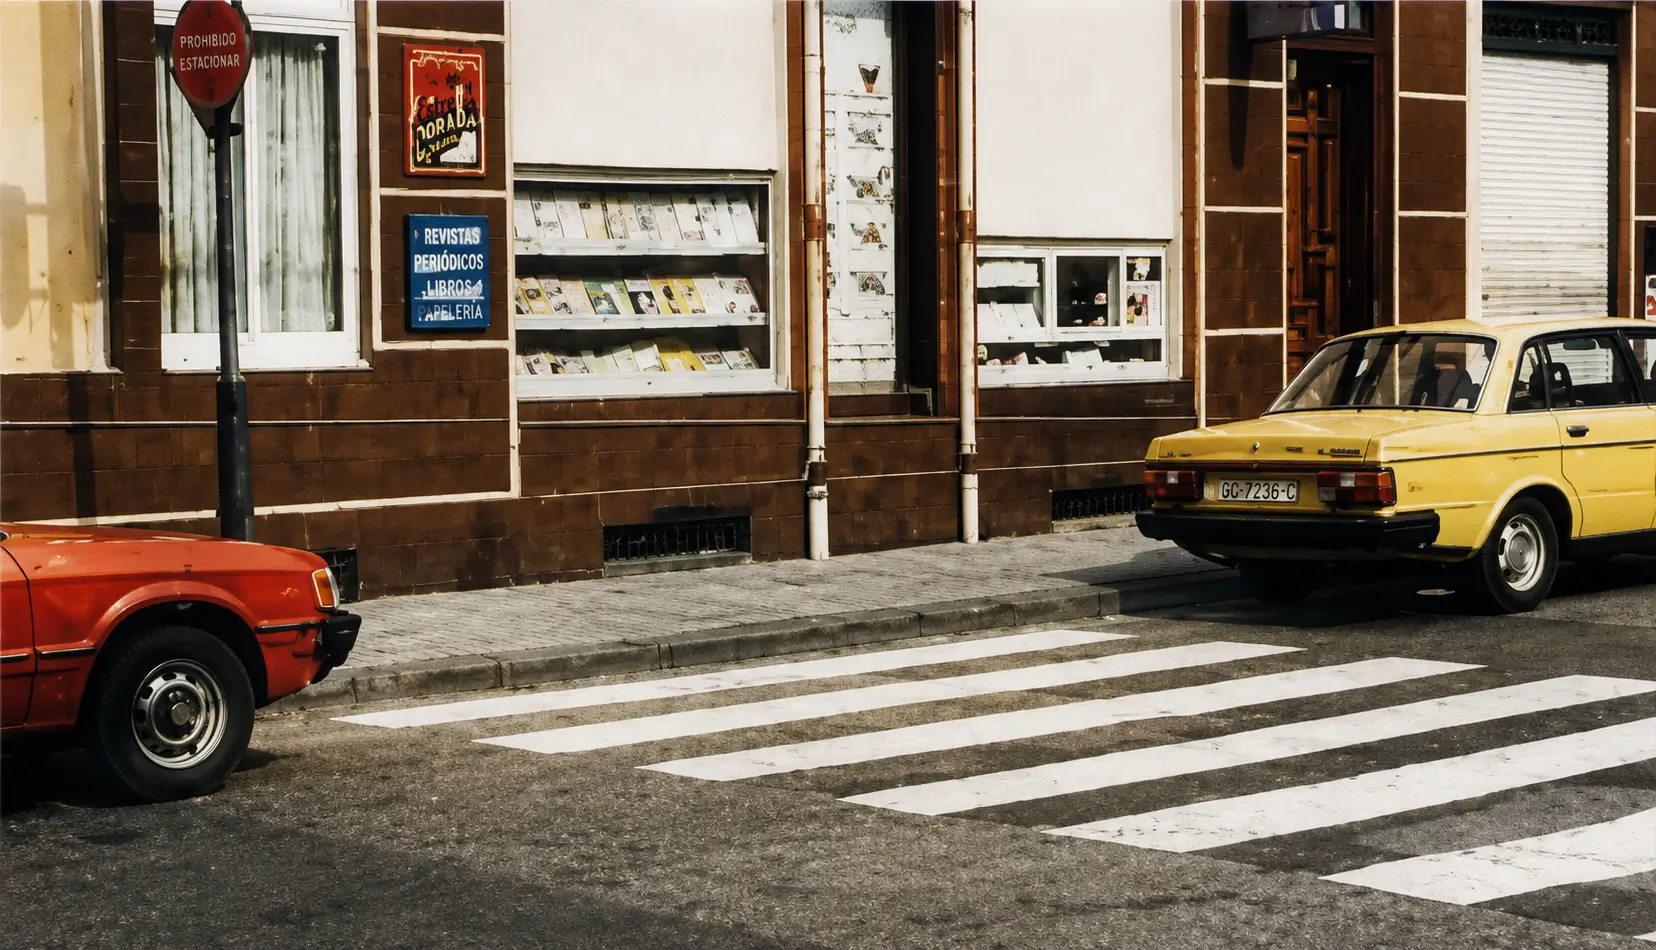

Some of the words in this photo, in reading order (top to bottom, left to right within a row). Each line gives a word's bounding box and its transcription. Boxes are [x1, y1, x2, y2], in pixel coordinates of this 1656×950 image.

[180, 32, 236, 49] PROHIBIDO
[180, 53, 240, 71] ESTACIONAR
[416, 108, 477, 140] DORADA
[424, 226, 482, 245] REVISTAS
[414, 250, 484, 273] PERIÓDICOS
[427, 279, 472, 297] LIBROS
[418, 300, 483, 321] PAPELERÍA
[1220, 481, 1296, 500] GC-7236-C
